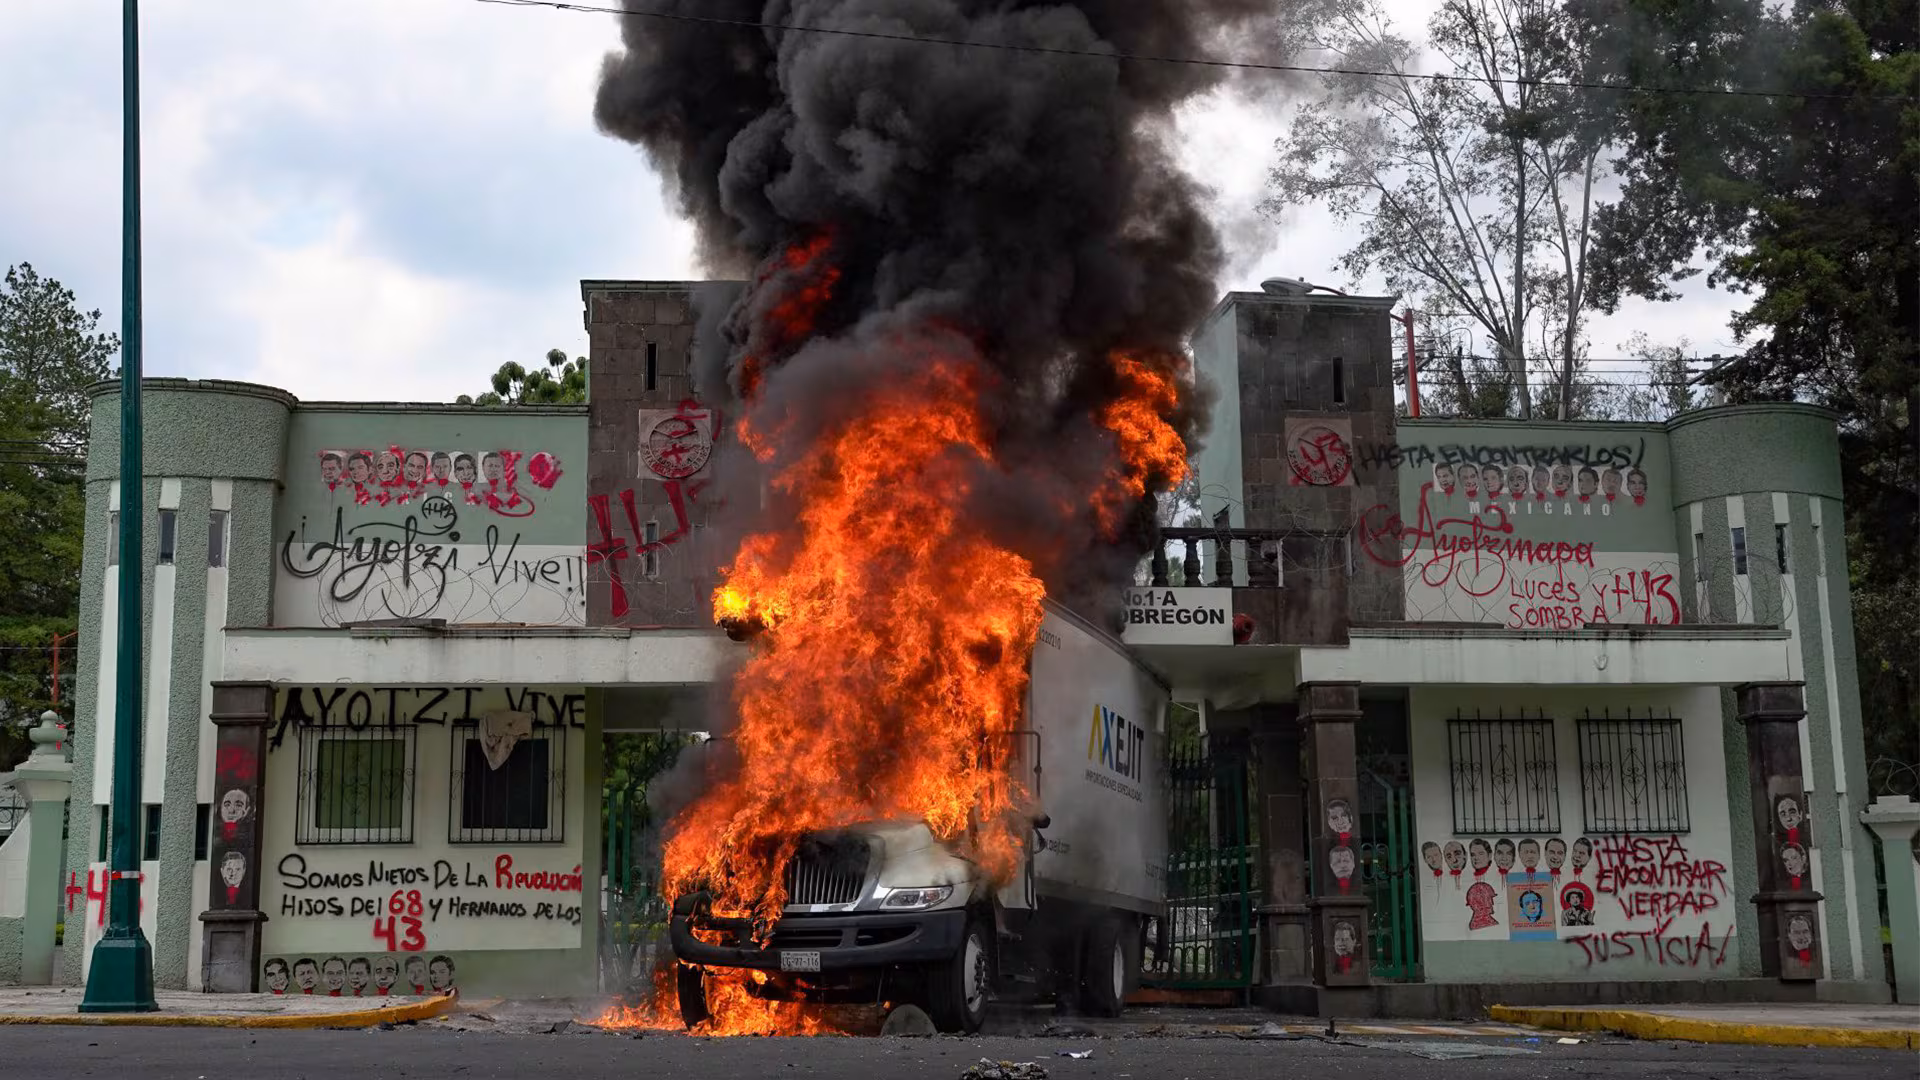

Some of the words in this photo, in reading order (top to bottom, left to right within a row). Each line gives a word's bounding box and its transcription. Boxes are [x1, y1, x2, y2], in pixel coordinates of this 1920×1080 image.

[269, 686, 483, 753] AYOTZI
[504, 687, 585, 730] VIVE
[1088, 703, 1144, 784] AXEJIT
[1596, 860, 1727, 897] ENCONTRAR
[65, 868, 145, 927] +4
[388, 889, 424, 917] 68
[1619, 891, 1718, 920] VERDAD
[373, 915, 426, 952] 43
